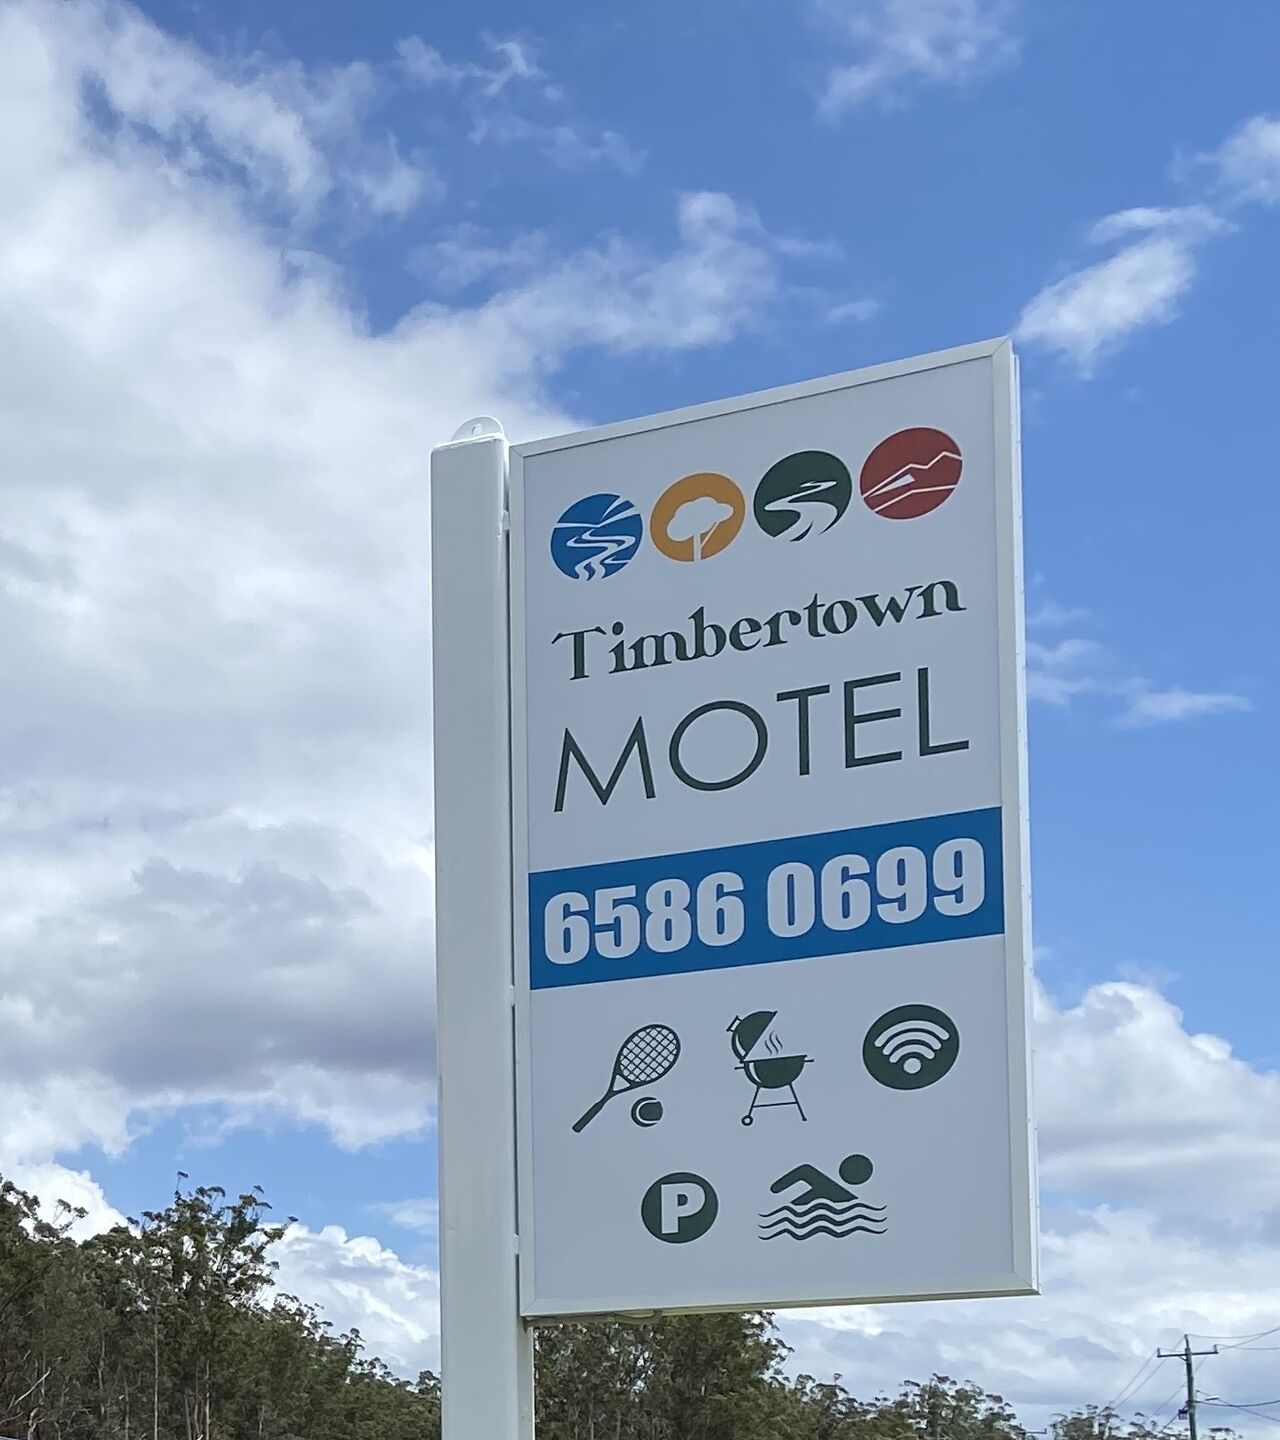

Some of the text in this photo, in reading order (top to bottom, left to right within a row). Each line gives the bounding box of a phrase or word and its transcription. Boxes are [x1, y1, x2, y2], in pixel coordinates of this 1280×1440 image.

[551, 579, 967, 681] Timbertown
[554, 667, 970, 813] MOTEL
[544, 837, 985, 965] 6586 0699
[661, 1183, 705, 1235] P
